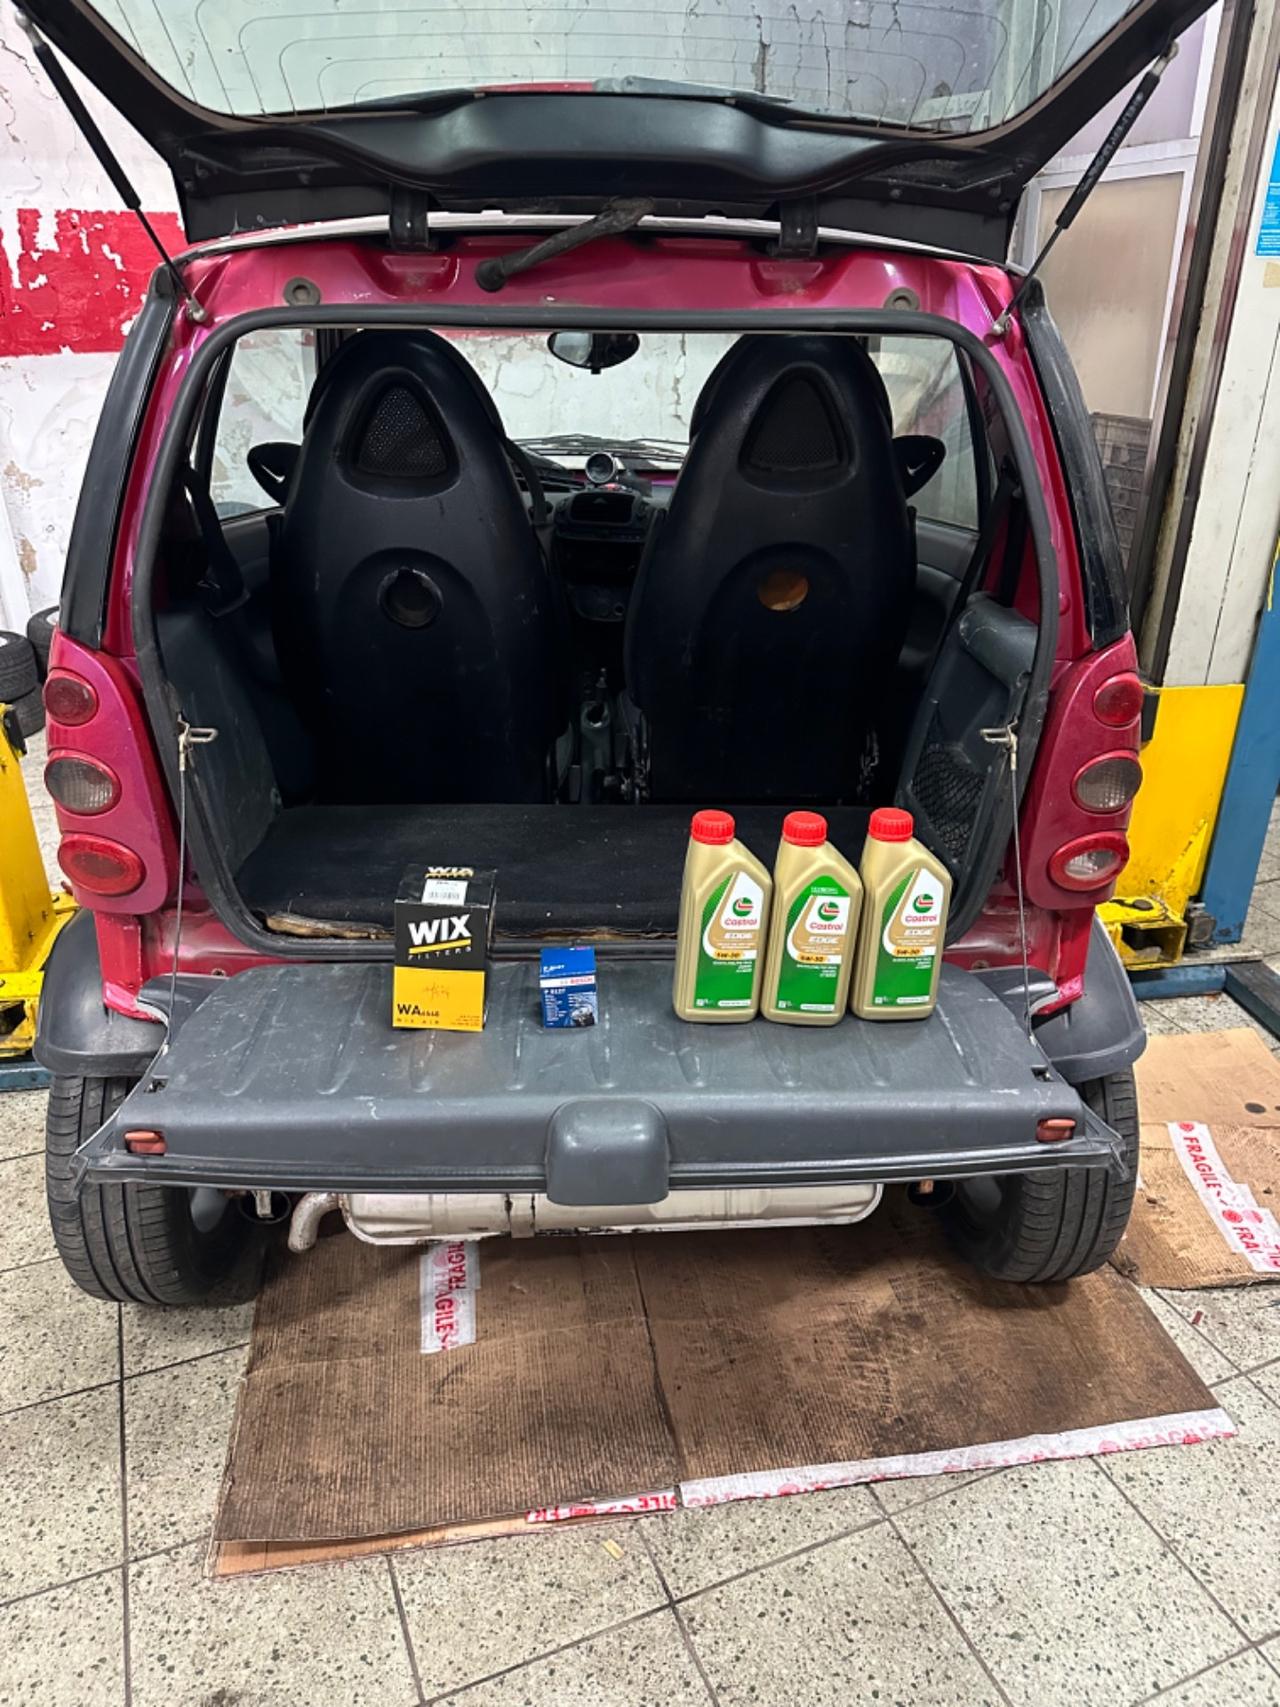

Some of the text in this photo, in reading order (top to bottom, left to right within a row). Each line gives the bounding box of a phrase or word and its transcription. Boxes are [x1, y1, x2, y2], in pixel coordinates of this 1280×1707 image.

[724, 918, 757, 926] Castrol
[905, 914, 937, 922] Castrol
[408, 914, 472, 945] WIX
[809, 922, 843, 930] Castrol
[408, 946, 472, 960] FILTERS
[1183, 1136, 1222, 1192] FRAGILE
